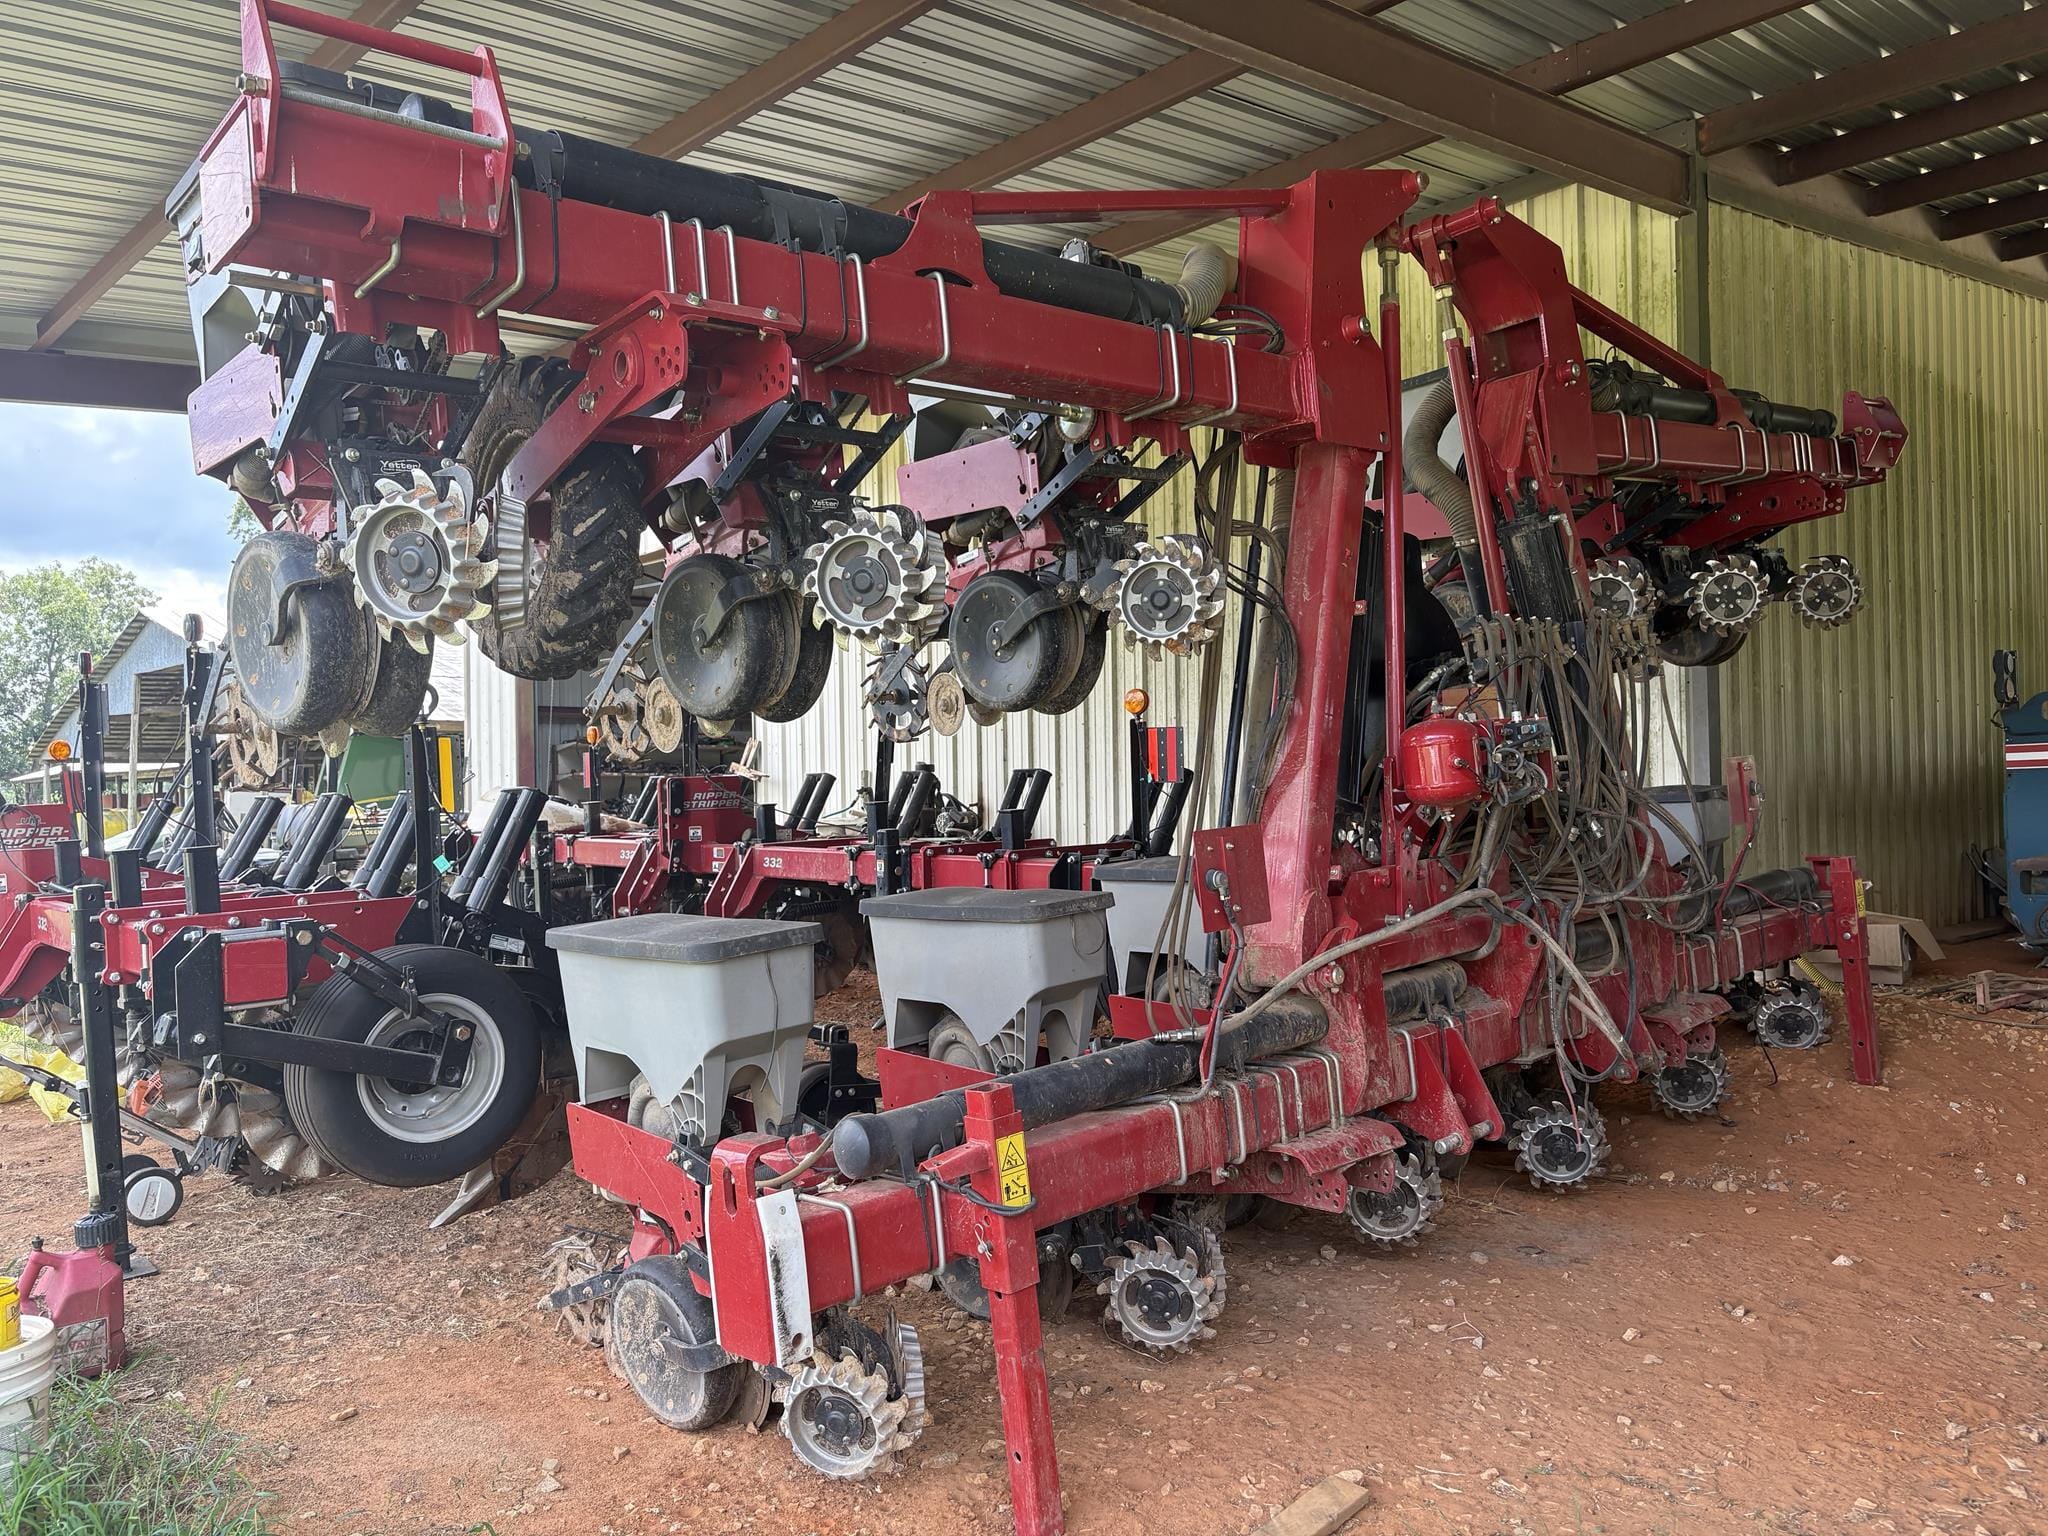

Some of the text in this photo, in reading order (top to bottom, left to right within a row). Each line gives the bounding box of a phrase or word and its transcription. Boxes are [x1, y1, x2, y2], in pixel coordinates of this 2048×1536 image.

[380, 460, 418, 470] Yetter
[811, 499, 838, 507] Yetter
[693, 792, 737, 800] RIPPER
[683, 800, 740, 809] STRIPPER
[763, 857, 783, 867] 332
